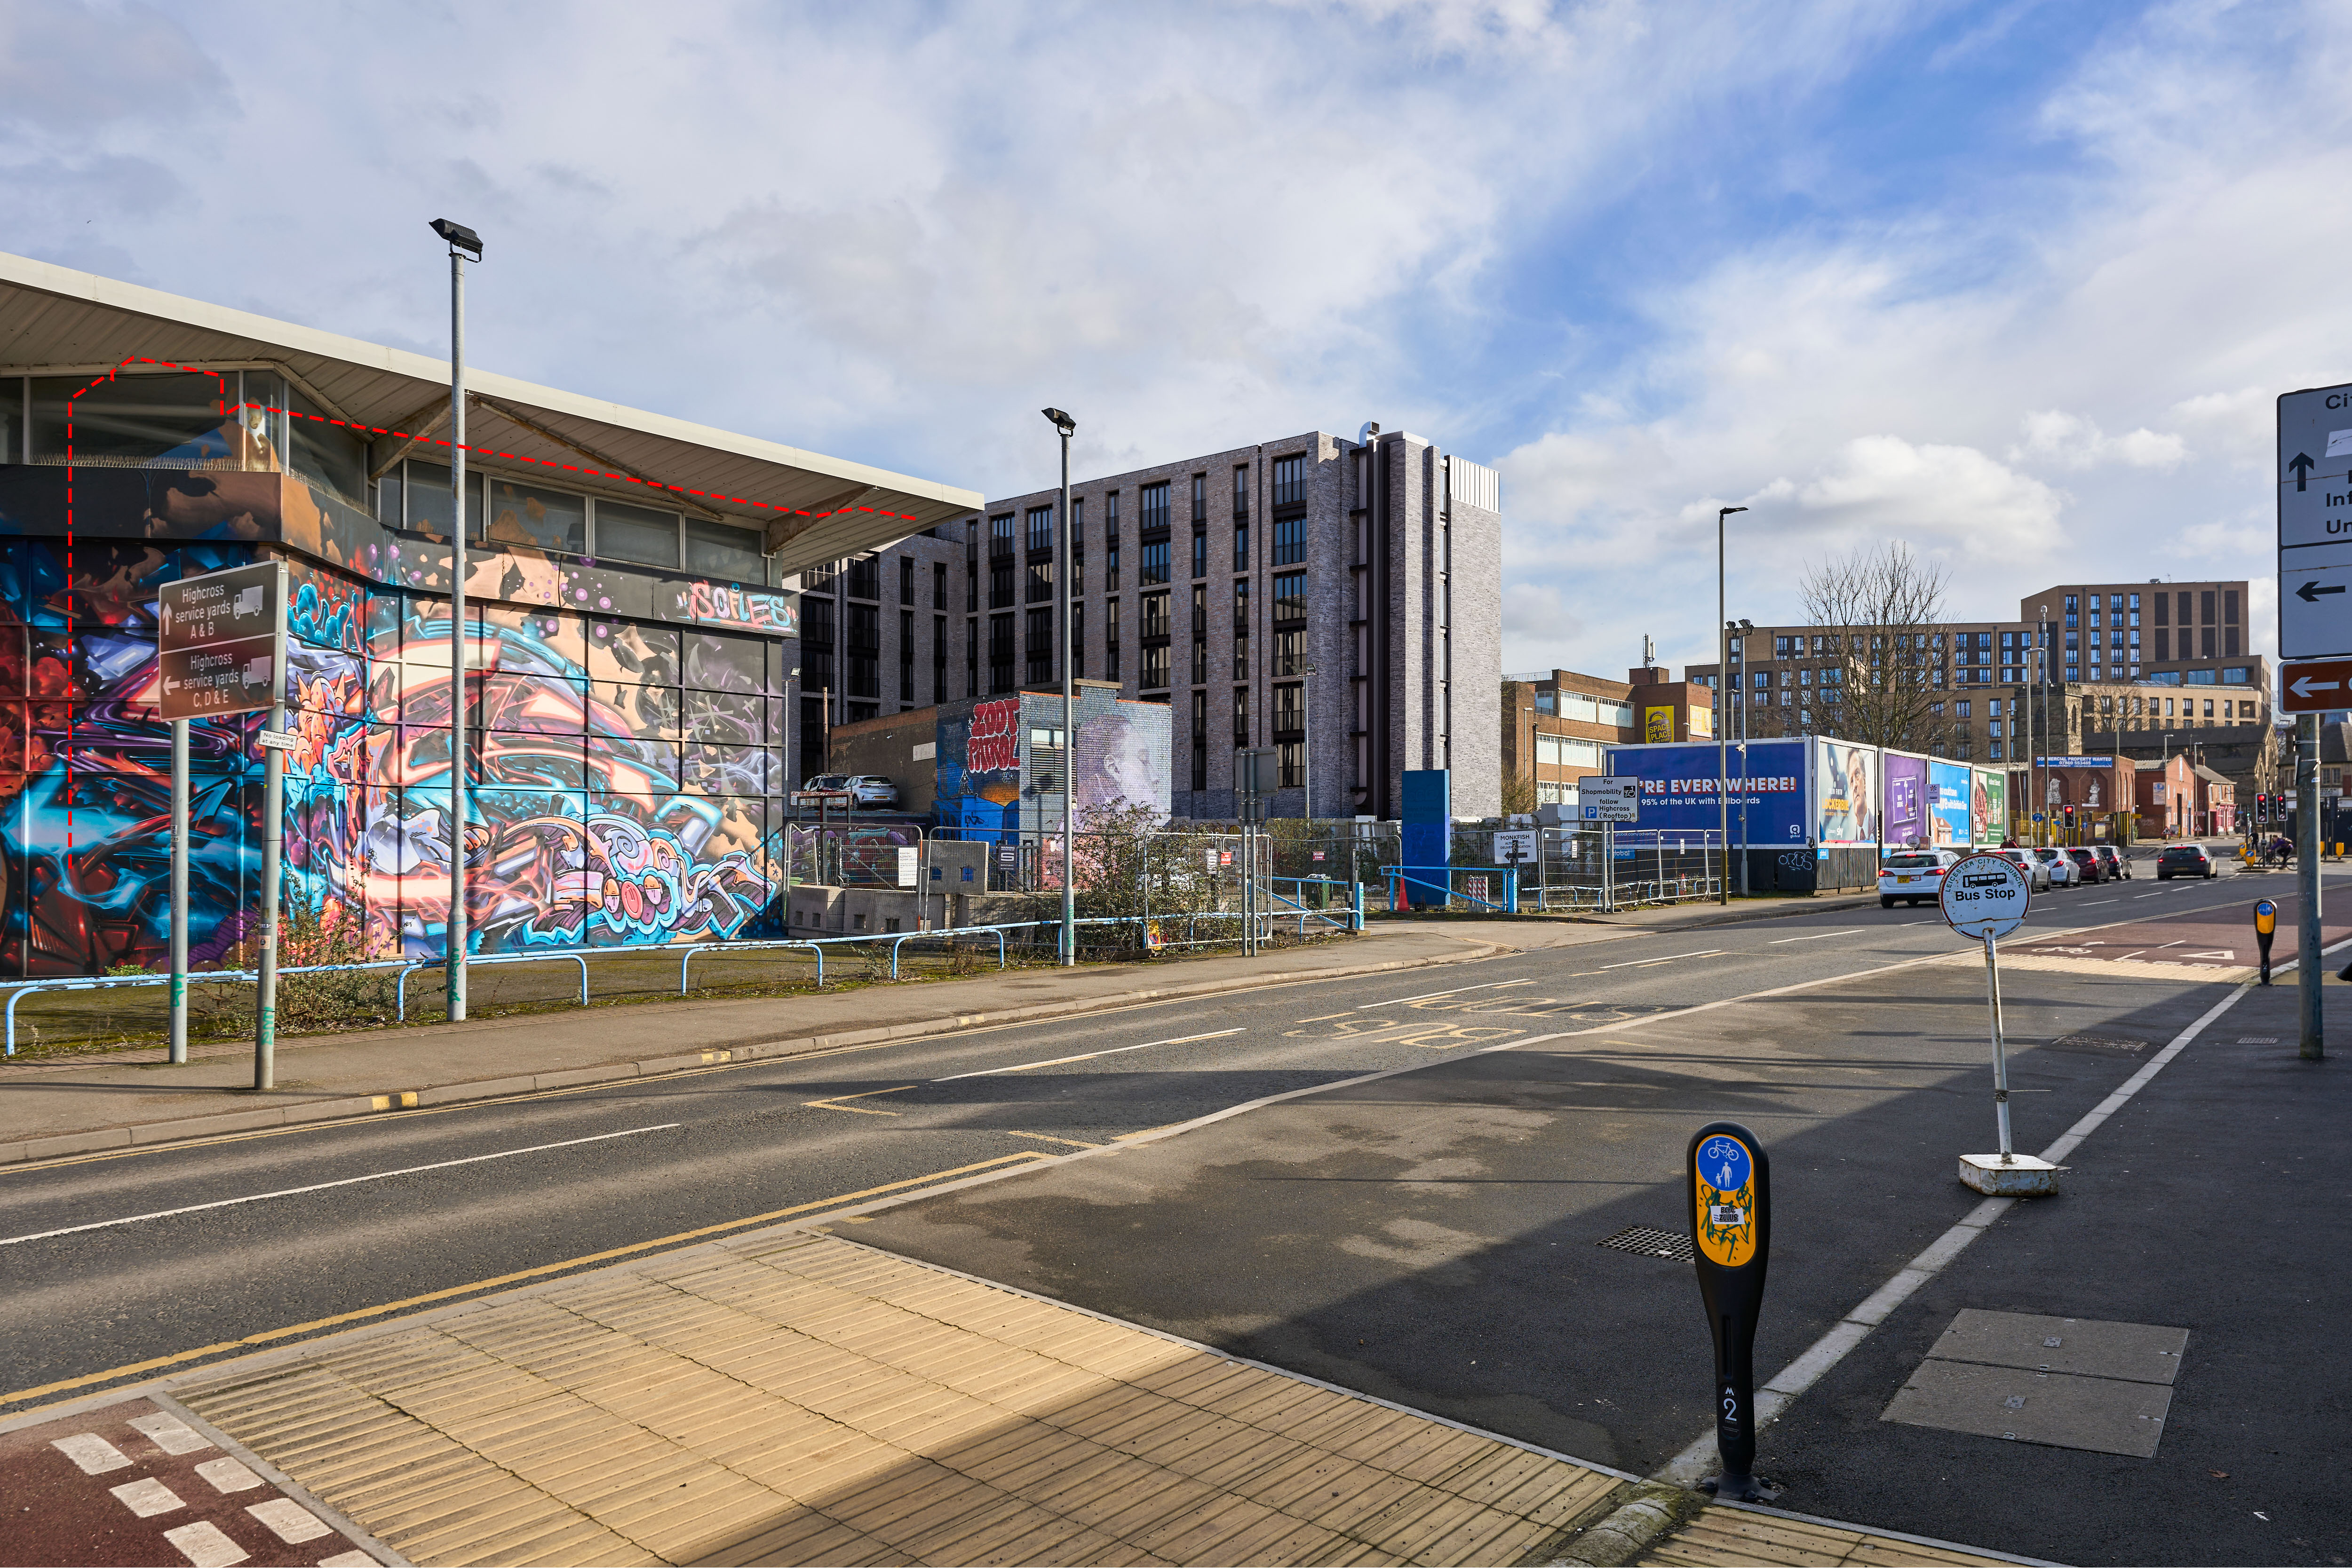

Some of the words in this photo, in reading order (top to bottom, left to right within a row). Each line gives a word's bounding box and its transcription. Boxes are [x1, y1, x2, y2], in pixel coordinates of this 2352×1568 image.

[2326, 393, 2352, 410] Ci
[183, 584, 224, 604] Highcross
[175, 607, 204, 623] service
[207, 601, 230, 620] yards
[191, 626, 196, 639] A
[199, 625, 205, 637] &
[208, 623, 214, 636] B
[191, 653, 232, 673] Highcross
[184, 674, 213, 690] service
[215, 669, 238, 688] yards
[205, 692, 211, 705] D
[214, 690, 220, 705] &
[223, 689, 229, 703] E
[971, 697, 1020, 737] ZOOT
[1649, 723, 1670, 733] SPACE
[1651, 730, 1671, 741] PLACE
[968, 734, 1020, 774] PATROL
[1671, 777, 1795, 792] EVERYWHERE!
[1822, 798, 1849, 810] LOCKERBIE
[1945, 861, 1974, 892] LEICESTER
[2000, 862, 2023, 888] COUNCIL
[1955, 891, 1980, 901] Bus
[1985, 888, 2016, 900] Stop
[1719, 1214, 1739, 1223] ZULUS
[1724, 1398, 1737, 1422] 2
